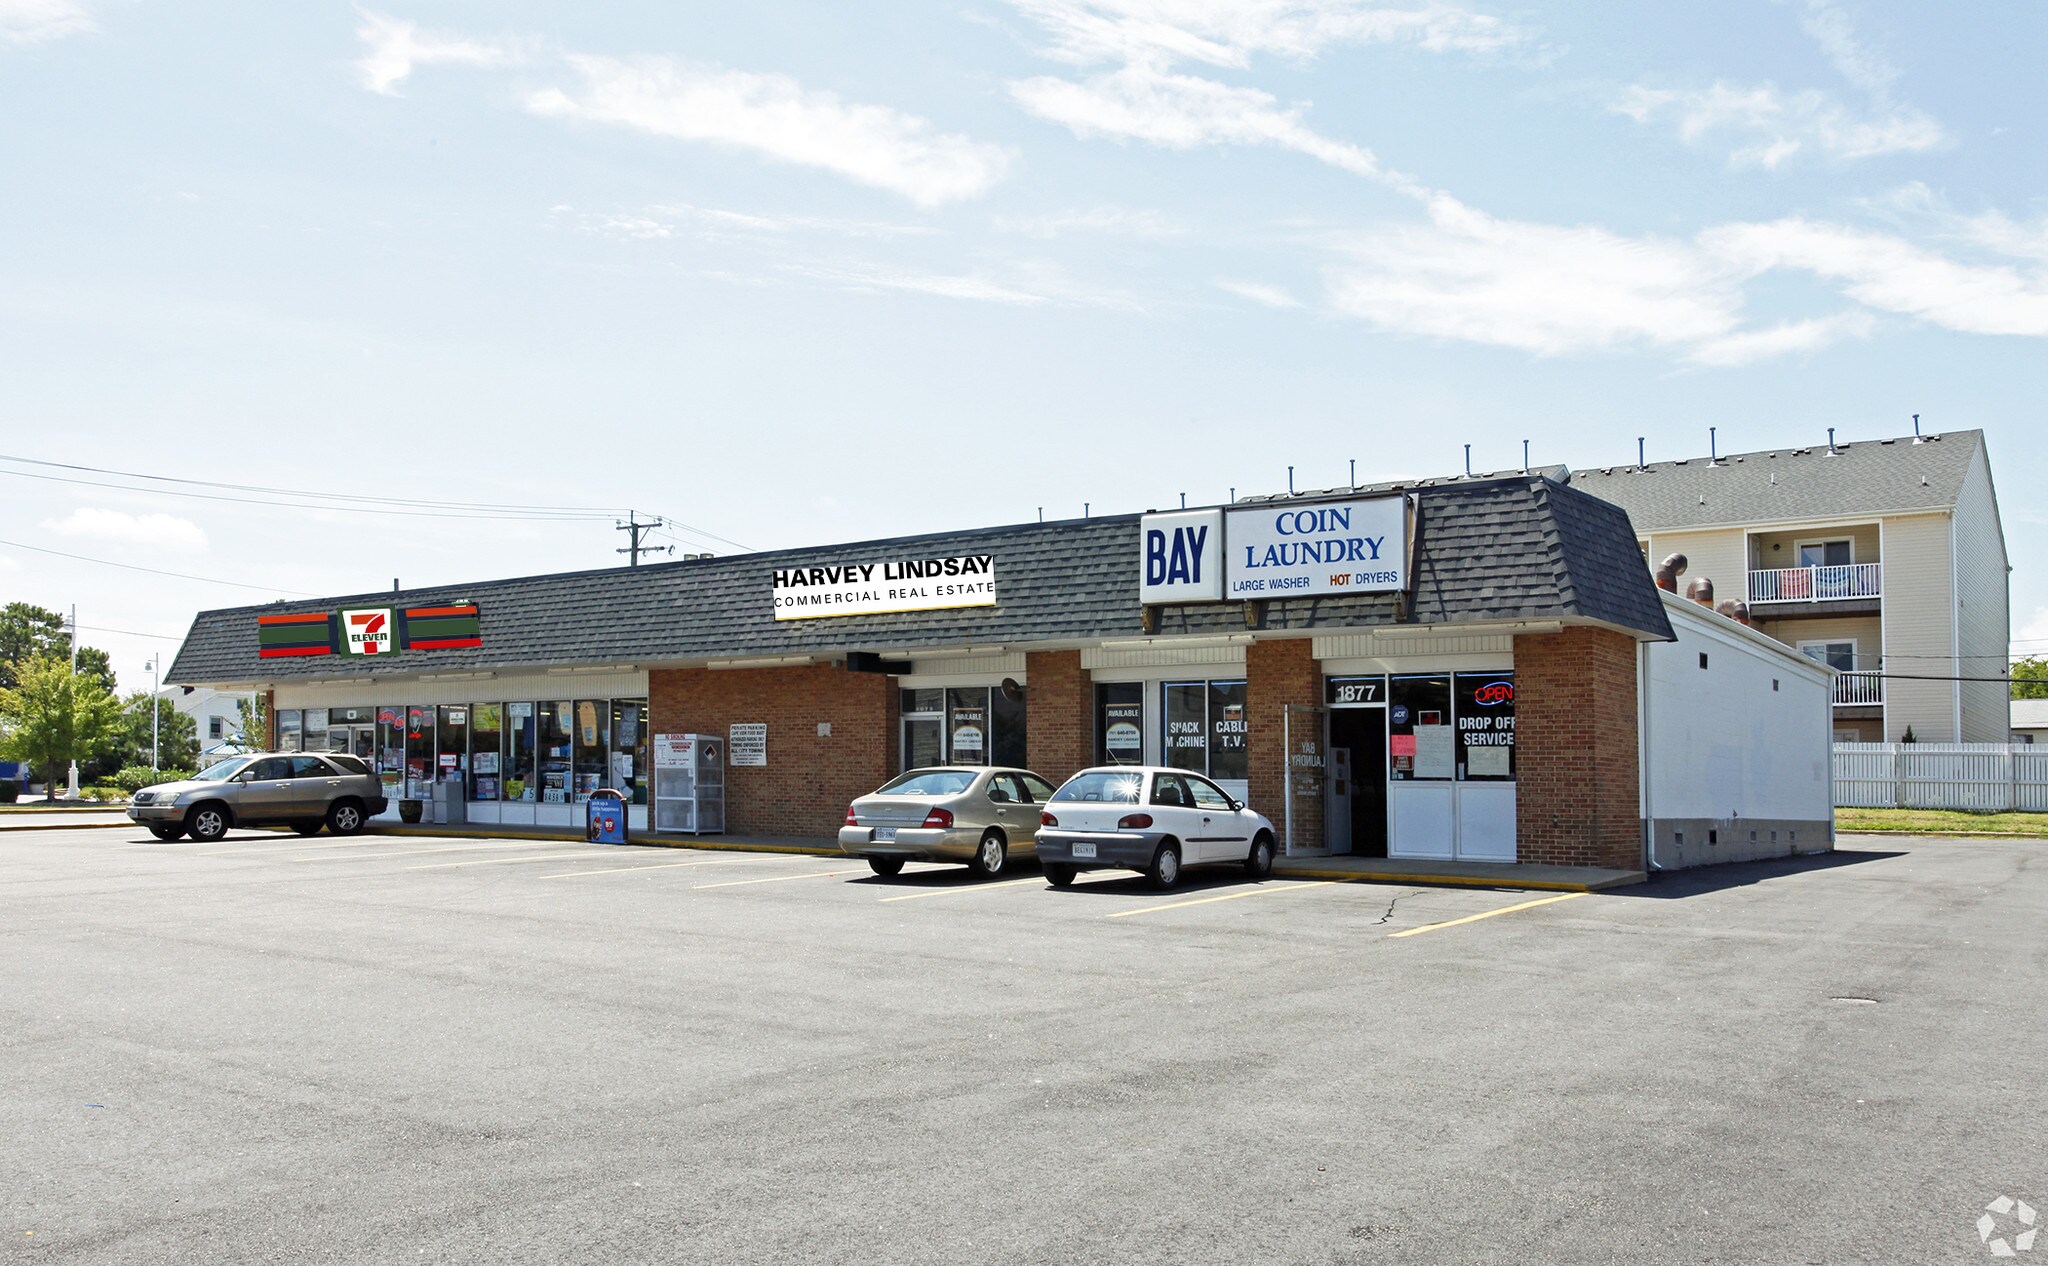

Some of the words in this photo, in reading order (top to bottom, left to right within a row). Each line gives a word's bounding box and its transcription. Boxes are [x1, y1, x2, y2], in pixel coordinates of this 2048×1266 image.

[1275, 507, 1352, 536] COIN
[1147, 526, 1208, 586] BAY
[1245, 536, 1385, 568] LAUNDRY
[773, 565, 875, 588] HARVEY
[884, 556, 993, 580] LINDSAY
[1233, 580, 1265, 592] LARGE
[1269, 577, 1310, 589] WASHER
[1330, 574, 1350, 587] HOT
[1355, 571, 1398, 584] DRYERS
[774, 590, 880, 607] COMMERCIAL
[889, 587, 928, 600] REAL
[936, 582, 994, 596] ESTATE
[1337, 685, 1376, 702] 1877
[1474, 686, 1514, 701] OPEN
[1108, 709, 1139, 717] AVAILABLE
[1459, 717, 1491, 730] DROP
[1166, 736, 1205, 747] MCHINE
[1222, 735, 1246, 747] T.V.
[1463, 732, 1514, 746] SERVICE
